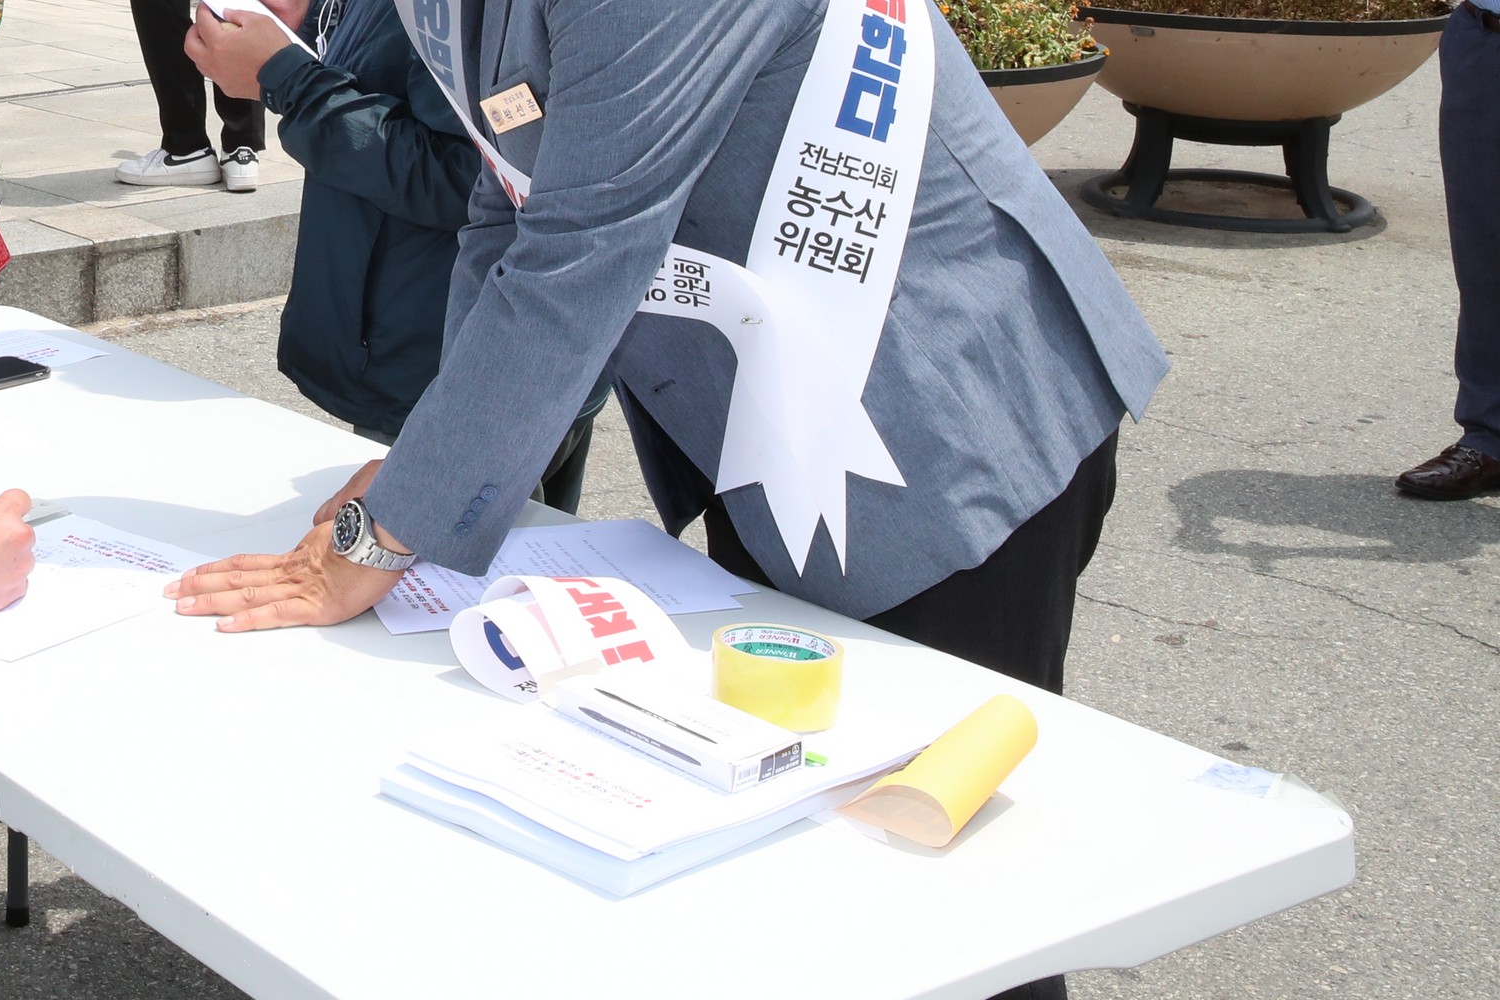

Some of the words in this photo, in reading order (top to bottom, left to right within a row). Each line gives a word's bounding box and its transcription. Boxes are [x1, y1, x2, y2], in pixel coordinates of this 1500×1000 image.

[798, 141, 899, 195] 전남도의회
[787, 176, 888, 239] 농수산
[773, 222, 875, 285] 위원회
[755, 648, 798, 659] WINNER
[758, 634, 800, 645] WINNER
